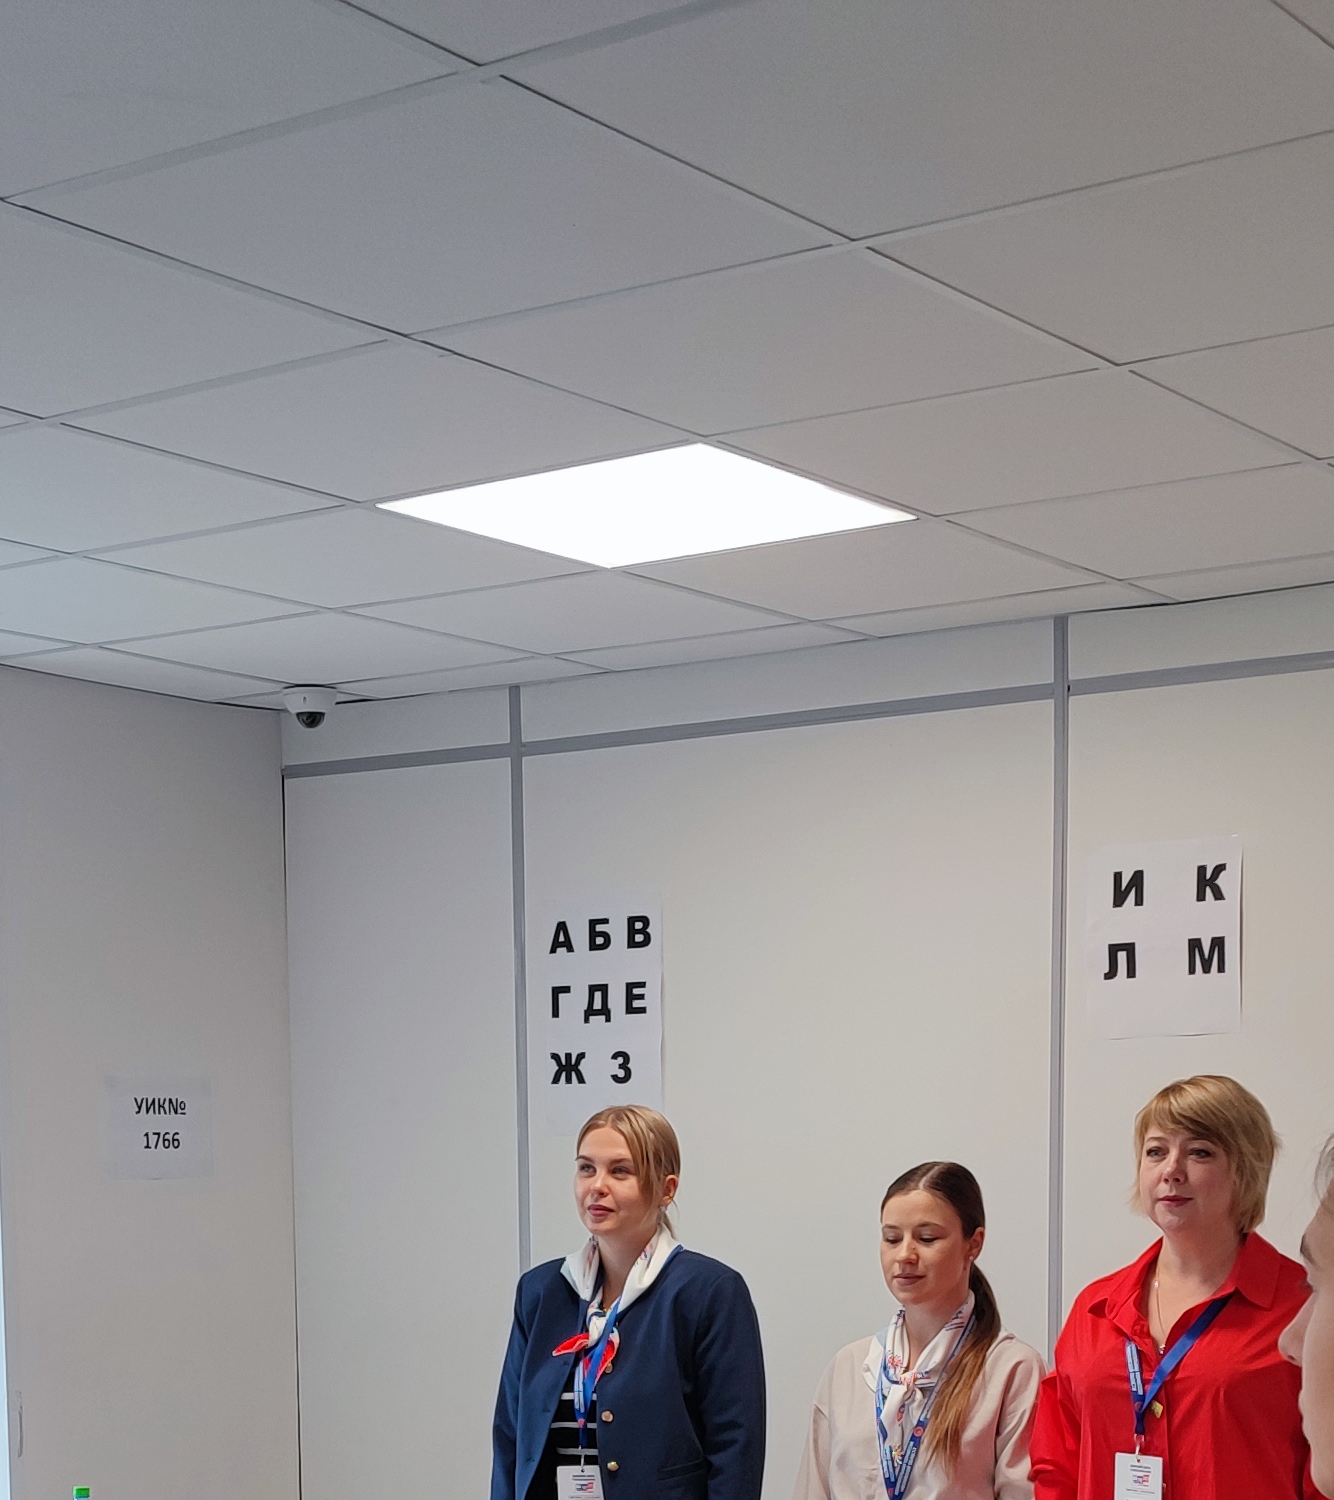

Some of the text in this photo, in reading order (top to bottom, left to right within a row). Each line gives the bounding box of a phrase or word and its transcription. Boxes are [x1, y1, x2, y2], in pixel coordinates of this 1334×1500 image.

[1112, 862, 1227, 908] И К
[1103, 936, 1226, 981] Л М
[549, 1052, 587, 1085] Ж
[133, 1096, 187, 1116] УИК№
[143, 1131, 181, 1150] 1766
